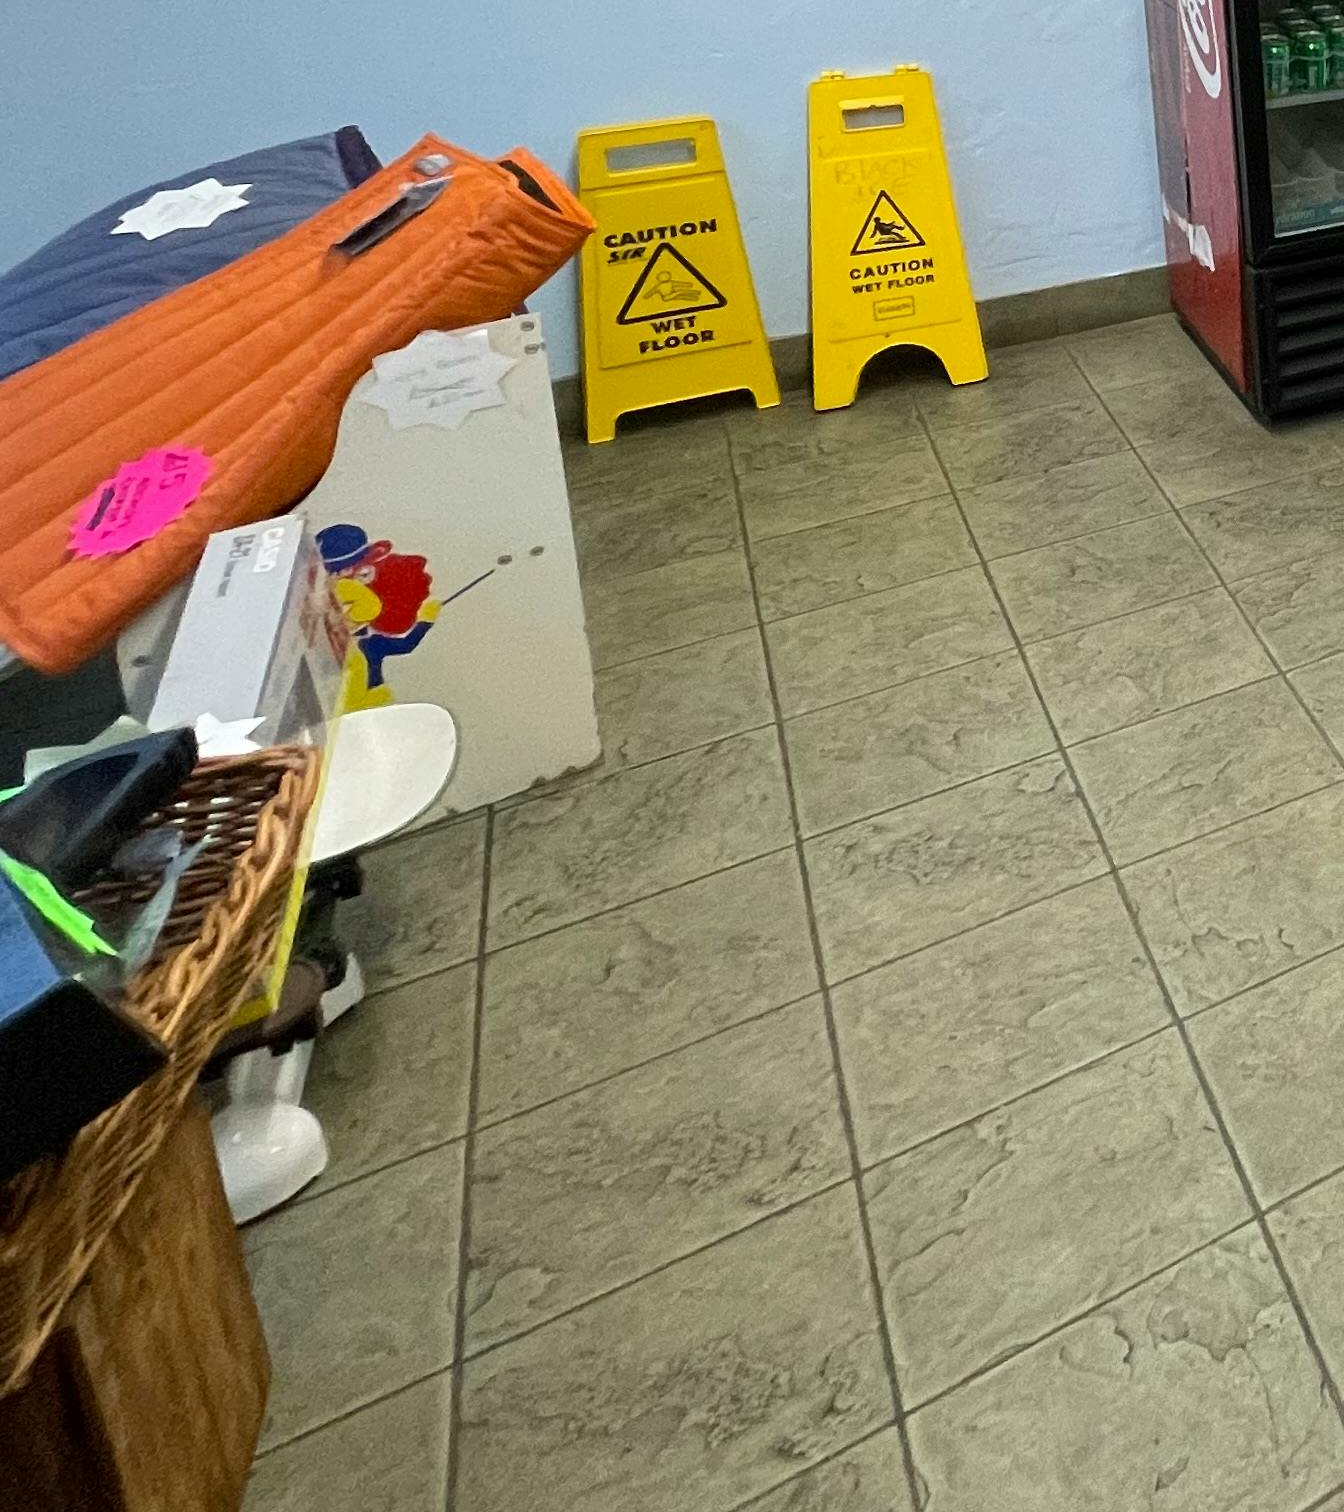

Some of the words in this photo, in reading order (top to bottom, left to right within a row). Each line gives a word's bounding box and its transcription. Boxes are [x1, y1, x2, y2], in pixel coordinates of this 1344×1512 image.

[604, 219, 717, 248] CAUTION
[850, 258, 933, 279] CAUTION
[852, 281, 882, 294] WET
[888, 275, 935, 290] FLOOR
[651, 315, 697, 334] WET
[639, 330, 714, 354] FLOOR
